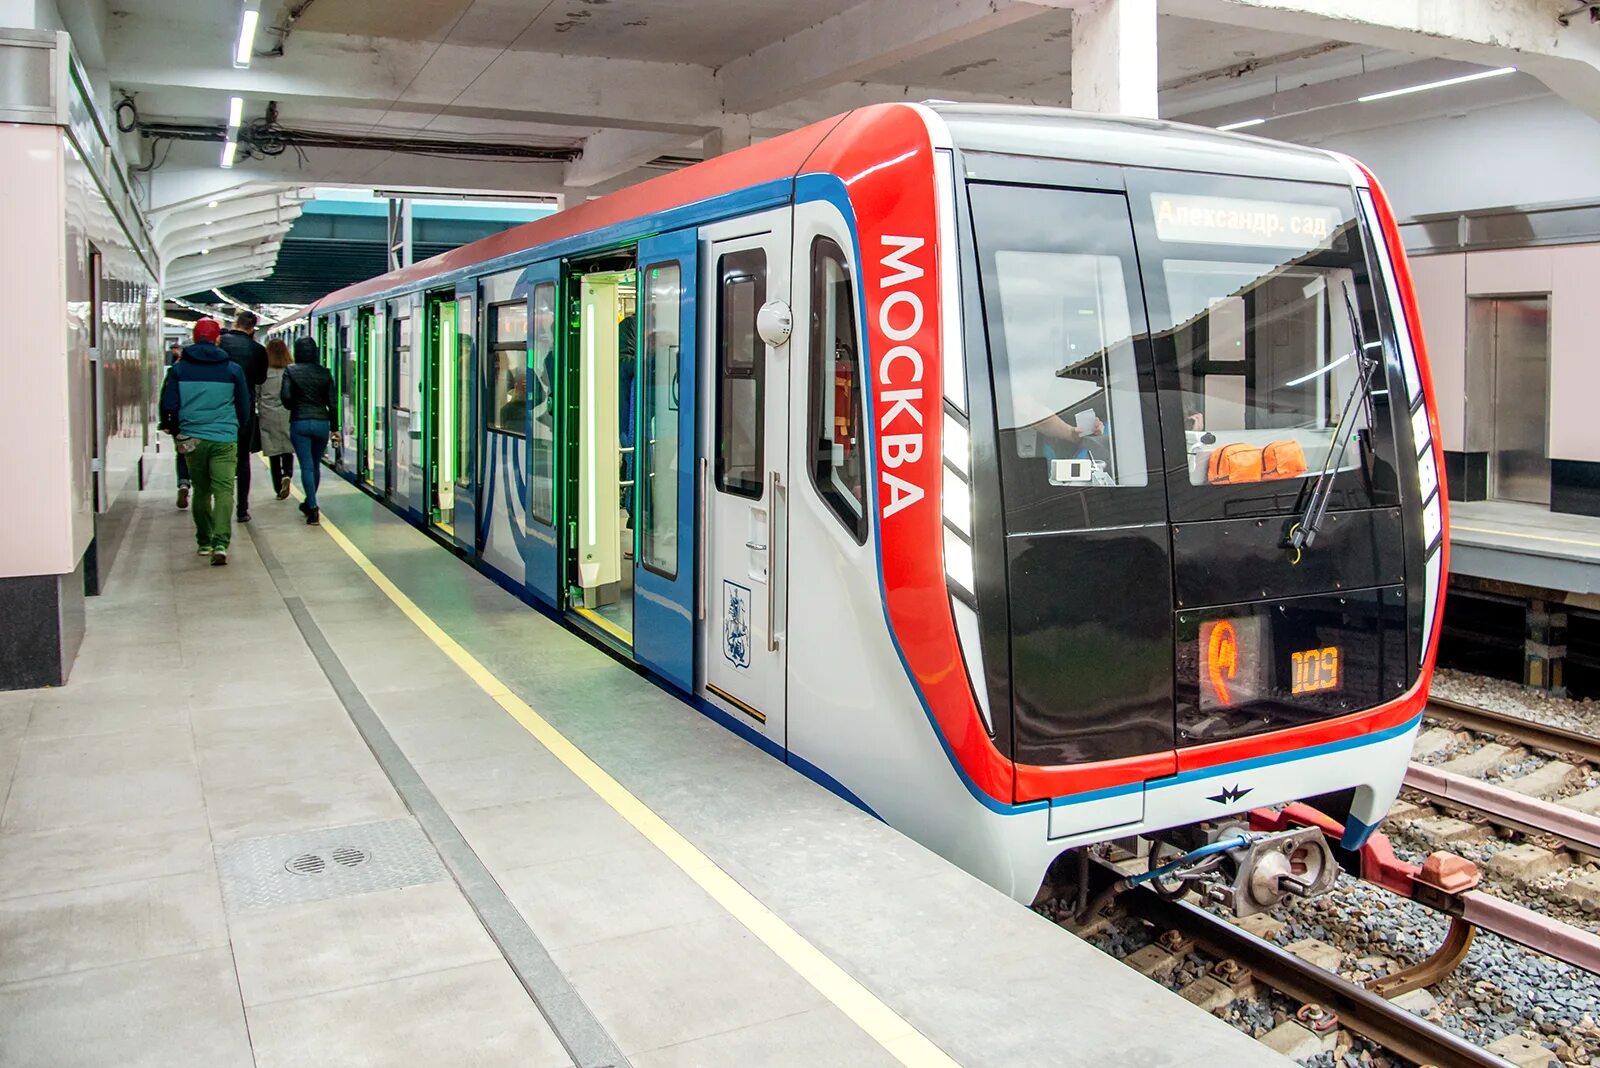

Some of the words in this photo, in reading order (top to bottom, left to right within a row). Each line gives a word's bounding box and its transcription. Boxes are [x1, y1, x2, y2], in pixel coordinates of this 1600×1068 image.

[1157, 199, 1285, 238] Александр.
[1290, 215, 1327, 239] сад
[879, 234, 926, 519] МОСКВА
